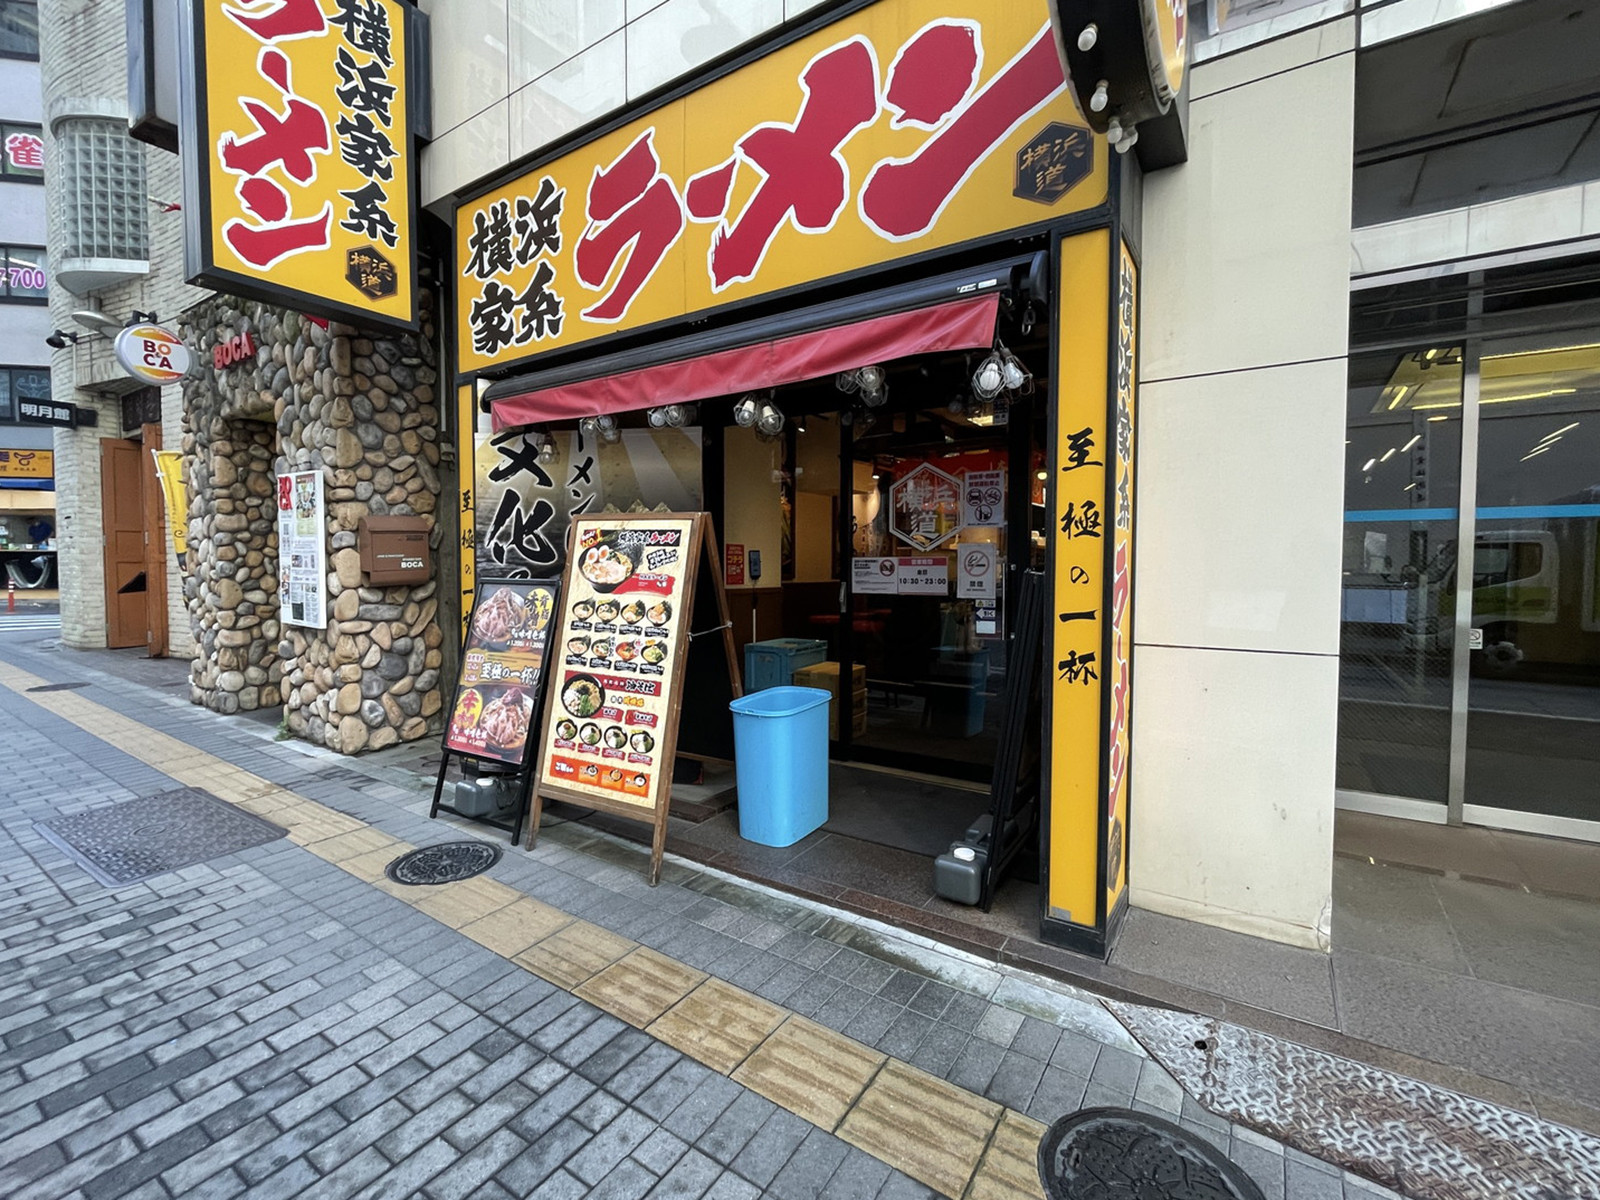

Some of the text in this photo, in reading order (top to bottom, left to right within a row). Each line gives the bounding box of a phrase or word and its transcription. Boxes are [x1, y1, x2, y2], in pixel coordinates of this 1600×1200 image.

[327, 0, 400, 247] 横浜家系
[573, 17, 1068, 324] ラーメン
[1035, 163, 1068, 196] 道
[21, 403, 70, 421] 明月館
[214, 331, 255, 370] BOCA
[1115, 253, 1133, 532] 横浜家系
[486, 429, 558, 579] 文化
[1057, 426, 1104, 686] 至極の一杯
[1108, 539, 1130, 822] ラーメン
